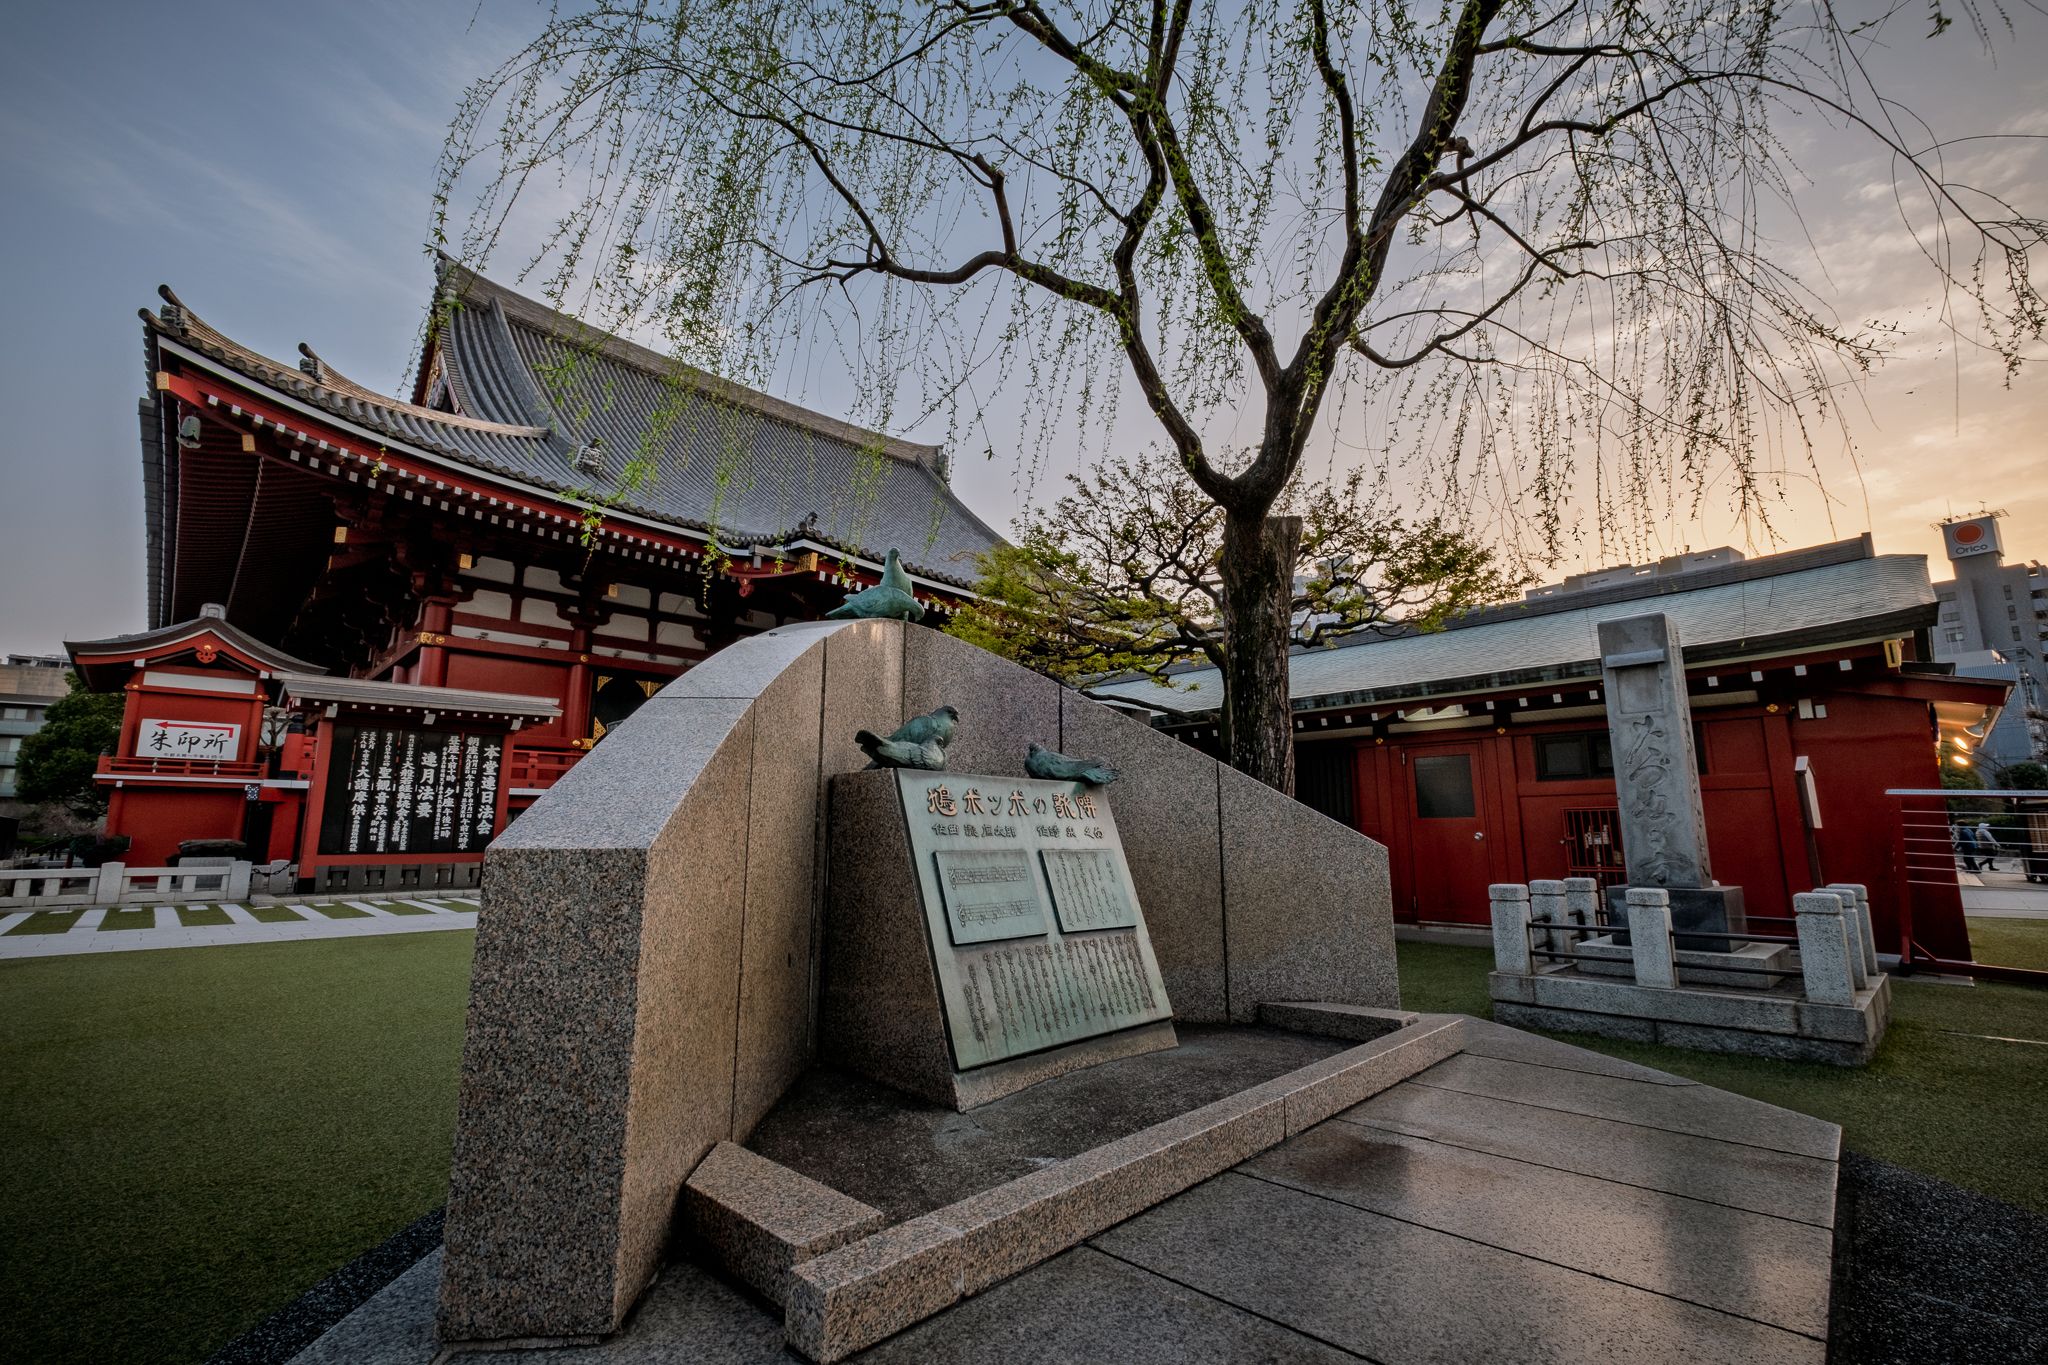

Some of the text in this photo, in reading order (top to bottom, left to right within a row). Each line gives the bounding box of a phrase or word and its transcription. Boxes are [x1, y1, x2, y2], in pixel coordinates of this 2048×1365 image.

[1955, 544, 1989, 556] Orico
[150, 729, 229, 754] 朱印所
